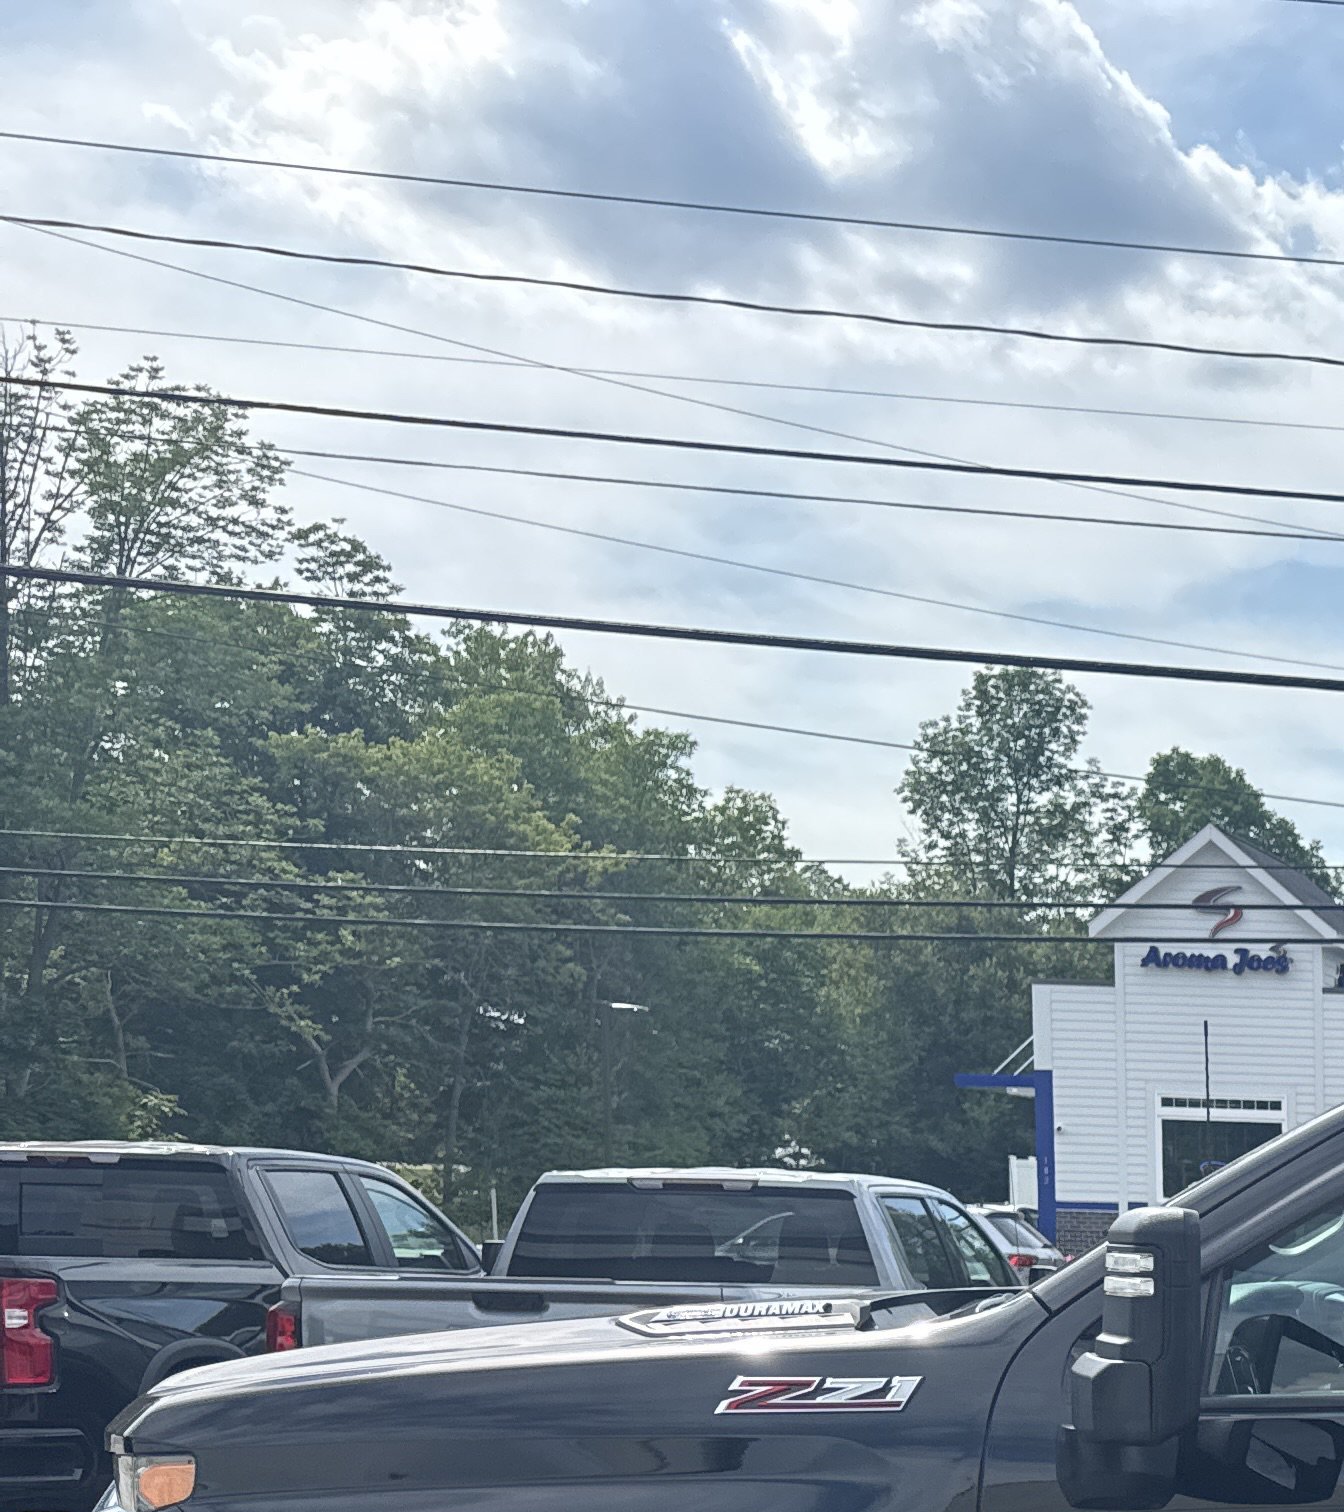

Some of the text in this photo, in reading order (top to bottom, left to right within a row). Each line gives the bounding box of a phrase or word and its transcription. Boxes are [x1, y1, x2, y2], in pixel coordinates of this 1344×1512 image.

[1140, 946, 1228, 972] Aroma
[718, 1301, 828, 1320] DURAMAX
[714, 1375, 926, 1415] Z71
